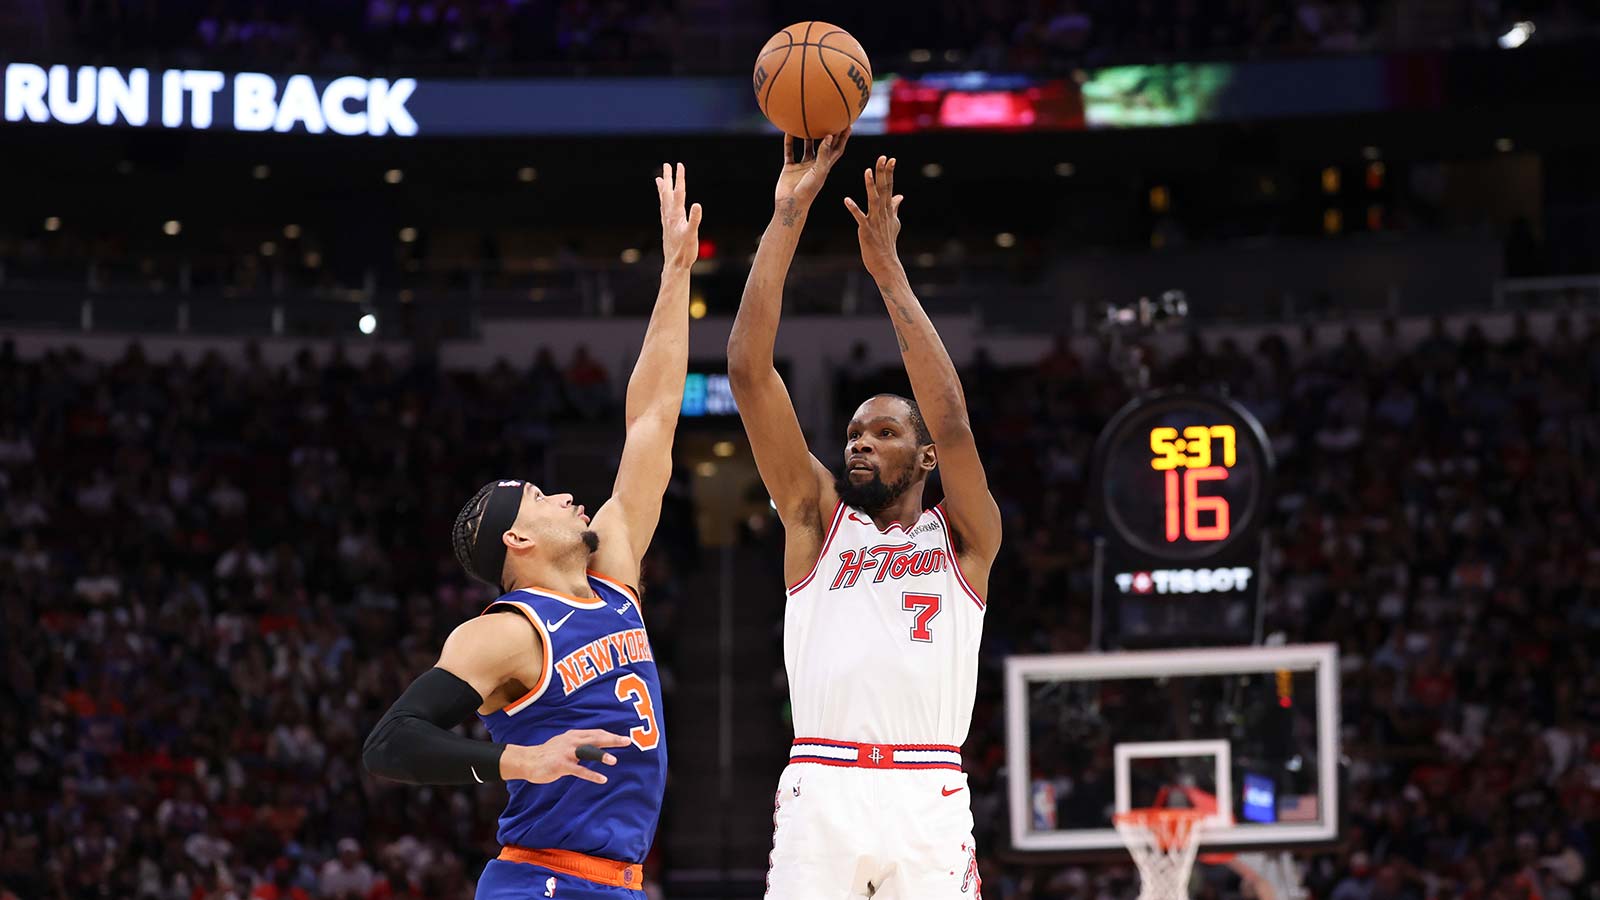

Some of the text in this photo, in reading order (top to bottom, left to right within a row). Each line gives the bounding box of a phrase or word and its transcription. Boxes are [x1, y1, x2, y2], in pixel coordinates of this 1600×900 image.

[4, 63, 419, 136] RUN IT BACK
[1150, 425, 1236, 470] 5:37
[1164, 466, 1230, 542] 16
[829, 541, 947, 590] H-Town
[1152, 567, 1253, 594] TISSOT
[902, 592, 942, 643] 7
[554, 636, 615, 697] NEW
[614, 672, 660, 752] 3
